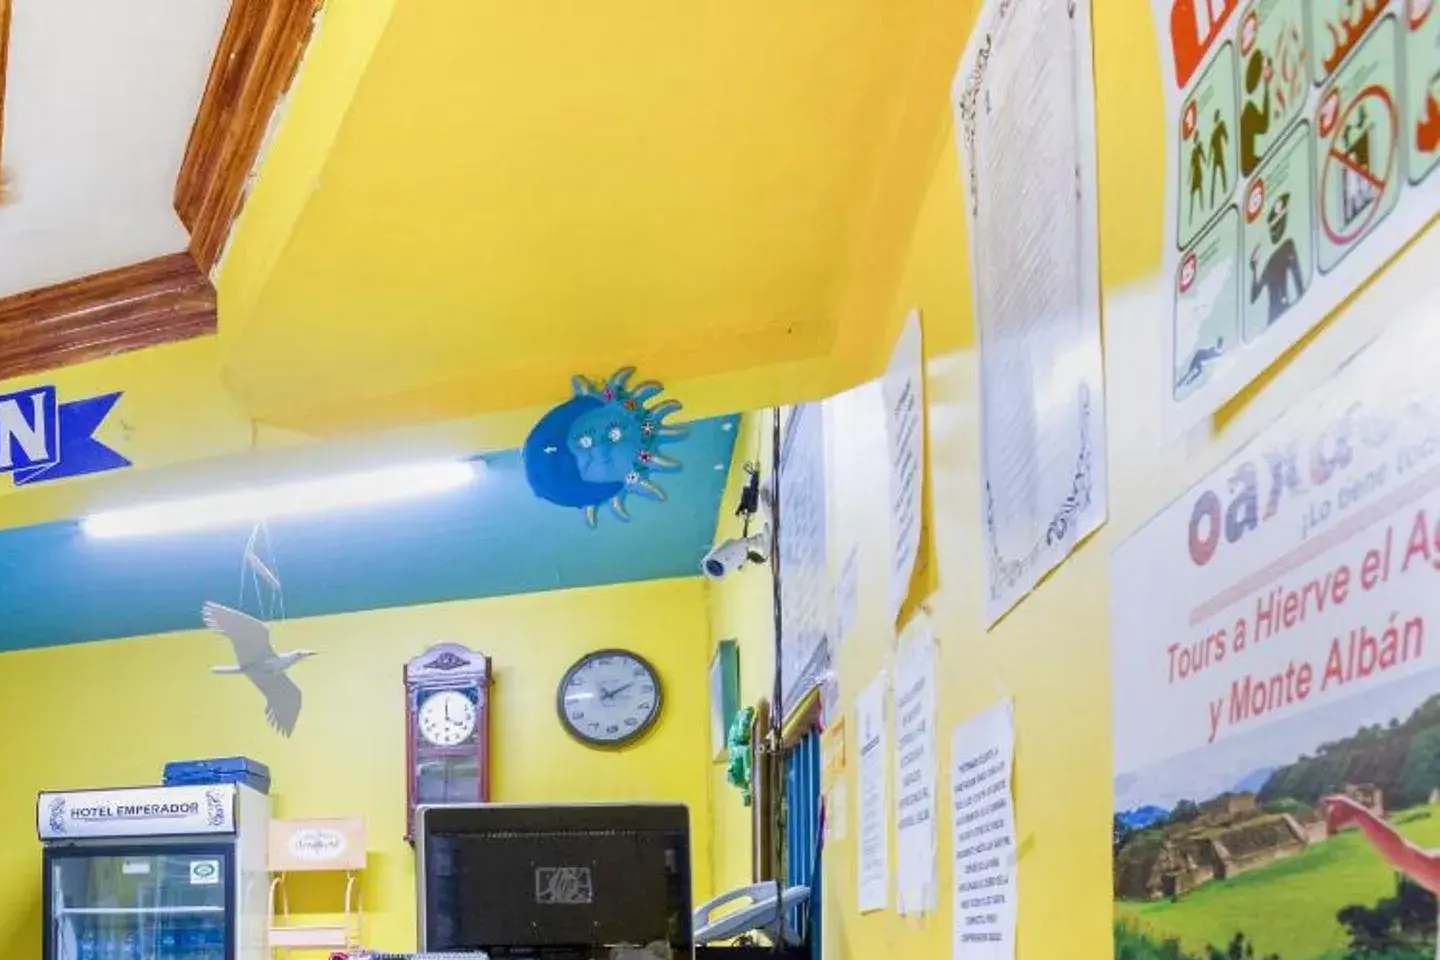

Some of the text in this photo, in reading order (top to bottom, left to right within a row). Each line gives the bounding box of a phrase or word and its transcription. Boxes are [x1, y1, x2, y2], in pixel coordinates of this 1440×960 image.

[1166, 627, 1227, 685] Tours
[1232, 617, 1247, 654] a
[1254, 564, 1351, 643] Hierve
[1360, 524, 1393, 591] el
[1208, 610, 1423, 744] y Monte Albán
[70, 801, 199, 818] HOTEL EMPERADOR
